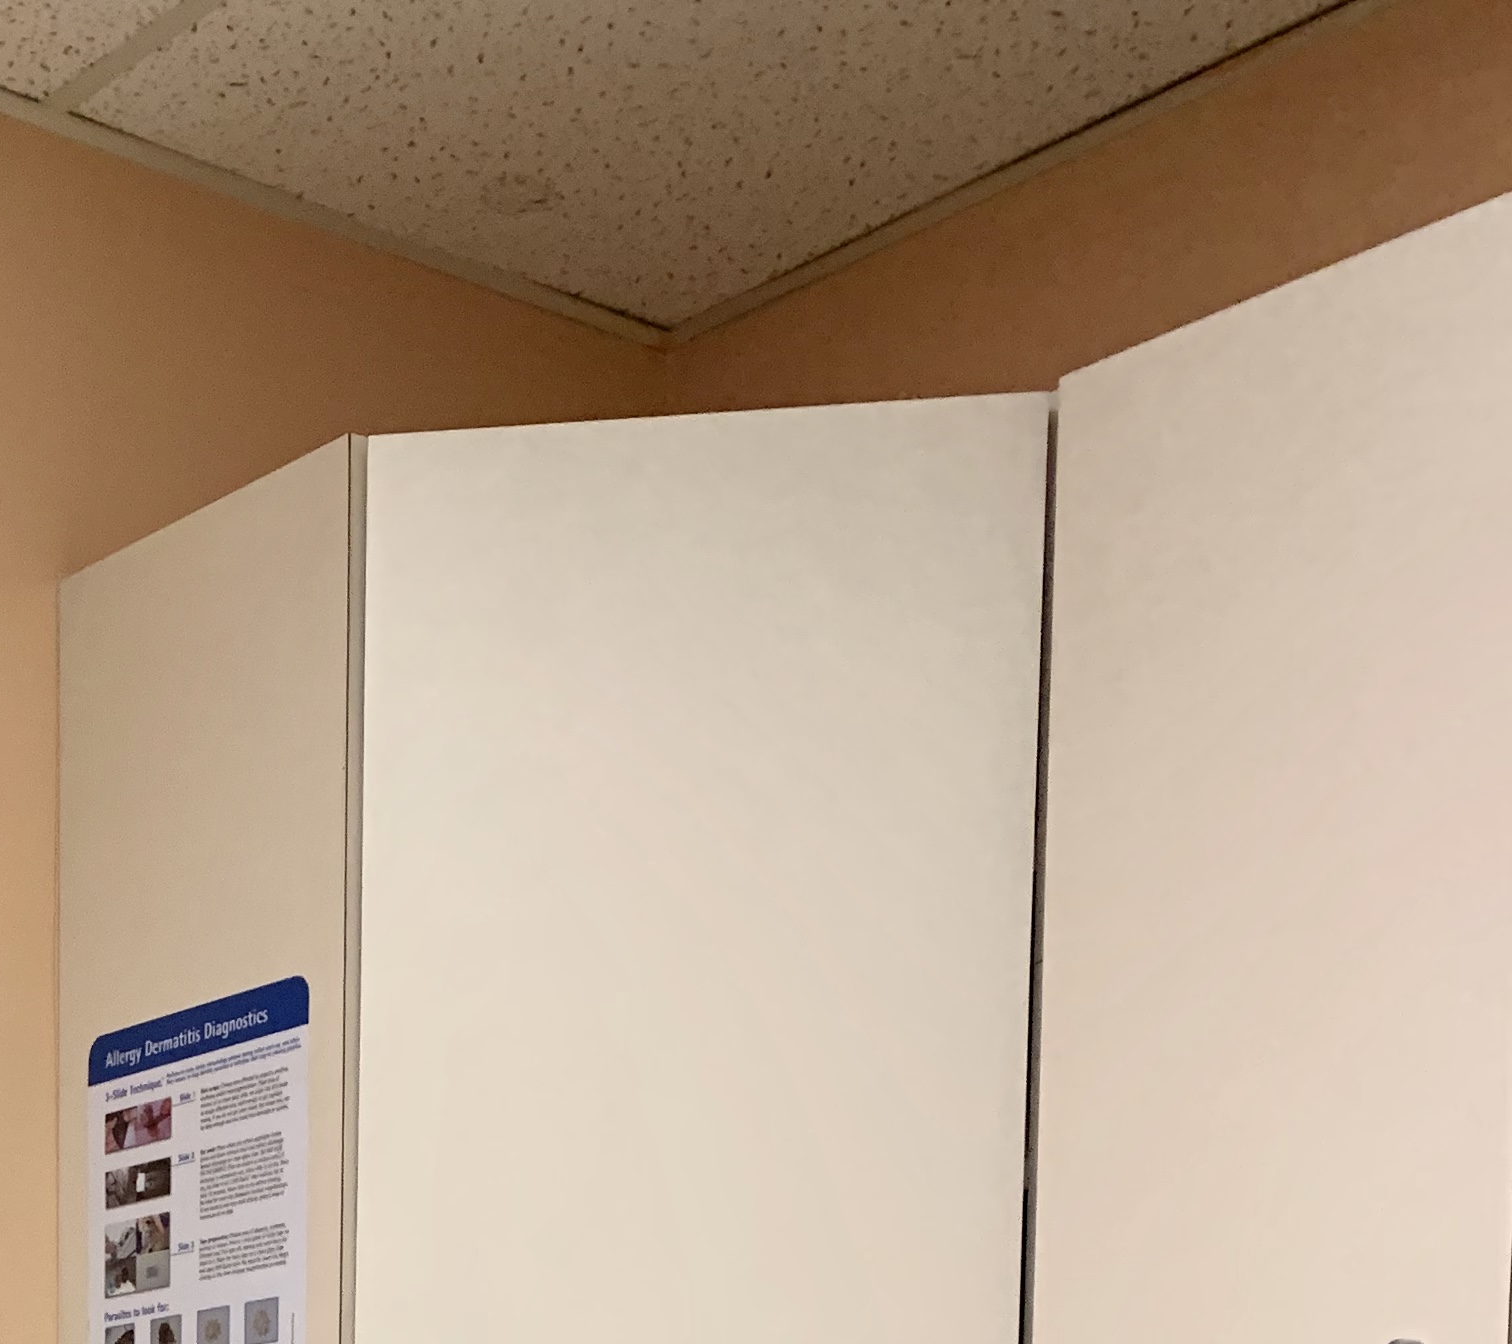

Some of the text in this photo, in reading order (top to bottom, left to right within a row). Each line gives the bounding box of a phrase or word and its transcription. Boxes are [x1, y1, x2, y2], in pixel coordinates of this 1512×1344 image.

[105, 1045, 143, 1070] Allergy
[144, 1025, 201, 1058] Dermatitis
[204, 1008, 269, 1041] Diagnostics
[133, 1306, 141, 1317] to
[142, 1304, 155, 1317] look
